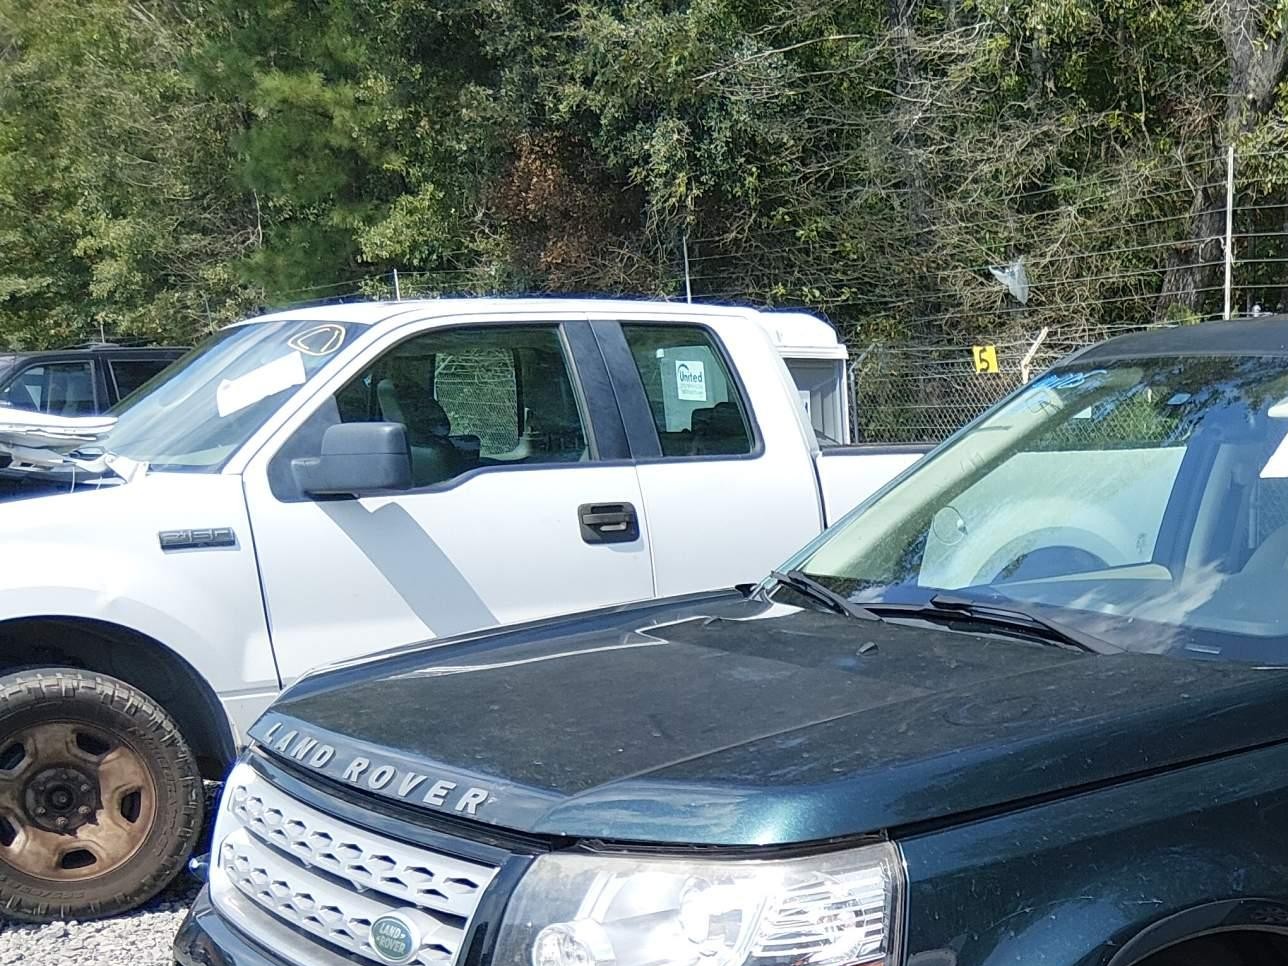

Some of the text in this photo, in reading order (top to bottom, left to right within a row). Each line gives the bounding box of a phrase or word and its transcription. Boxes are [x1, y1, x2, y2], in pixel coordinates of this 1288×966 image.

[978, 347, 990, 373] 5
[265, 722, 490, 815] LAND ROVER
